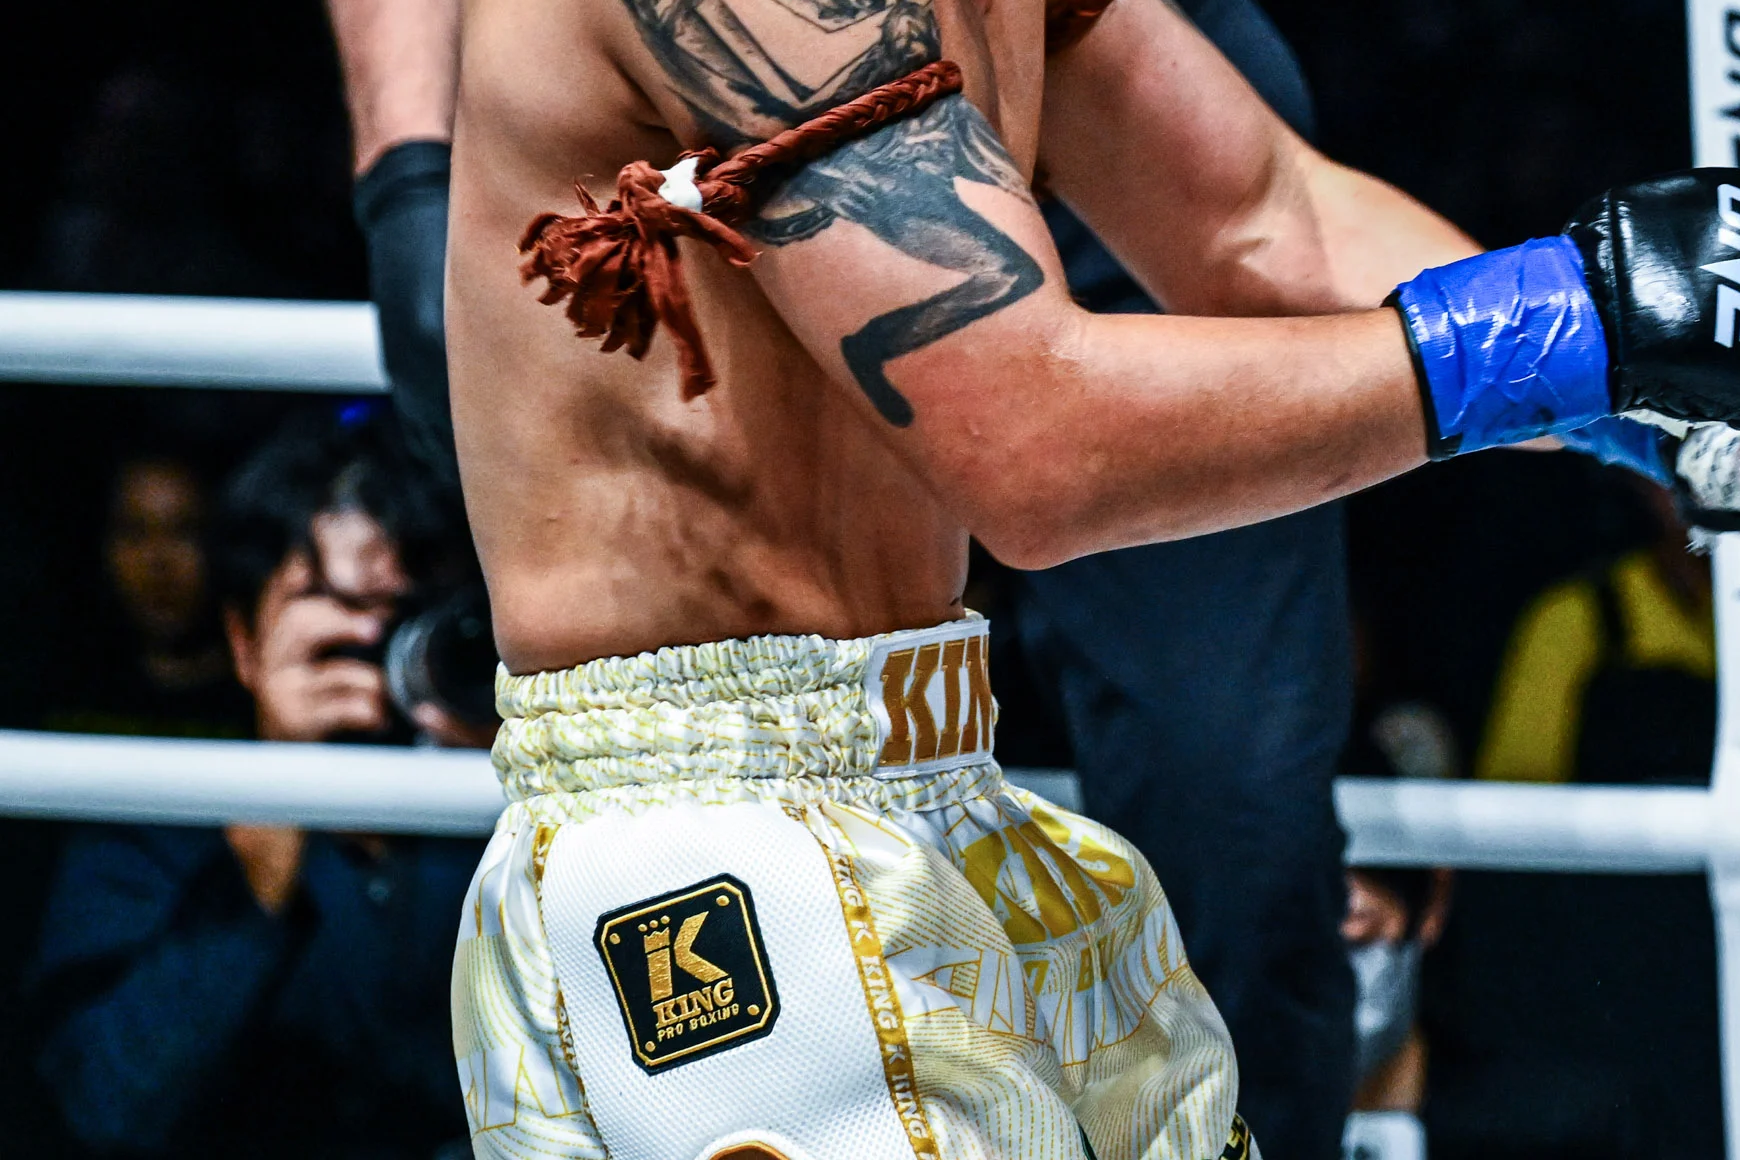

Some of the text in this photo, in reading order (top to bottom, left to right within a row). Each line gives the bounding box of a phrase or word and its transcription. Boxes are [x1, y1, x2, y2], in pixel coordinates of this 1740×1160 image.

[878, 634, 991, 766] KIN
[652, 977, 734, 1029] KING
[657, 1003, 740, 1042] PRO BOXING
[860, 956, 899, 1030] KING
[892, 1074, 930, 1139] KING
